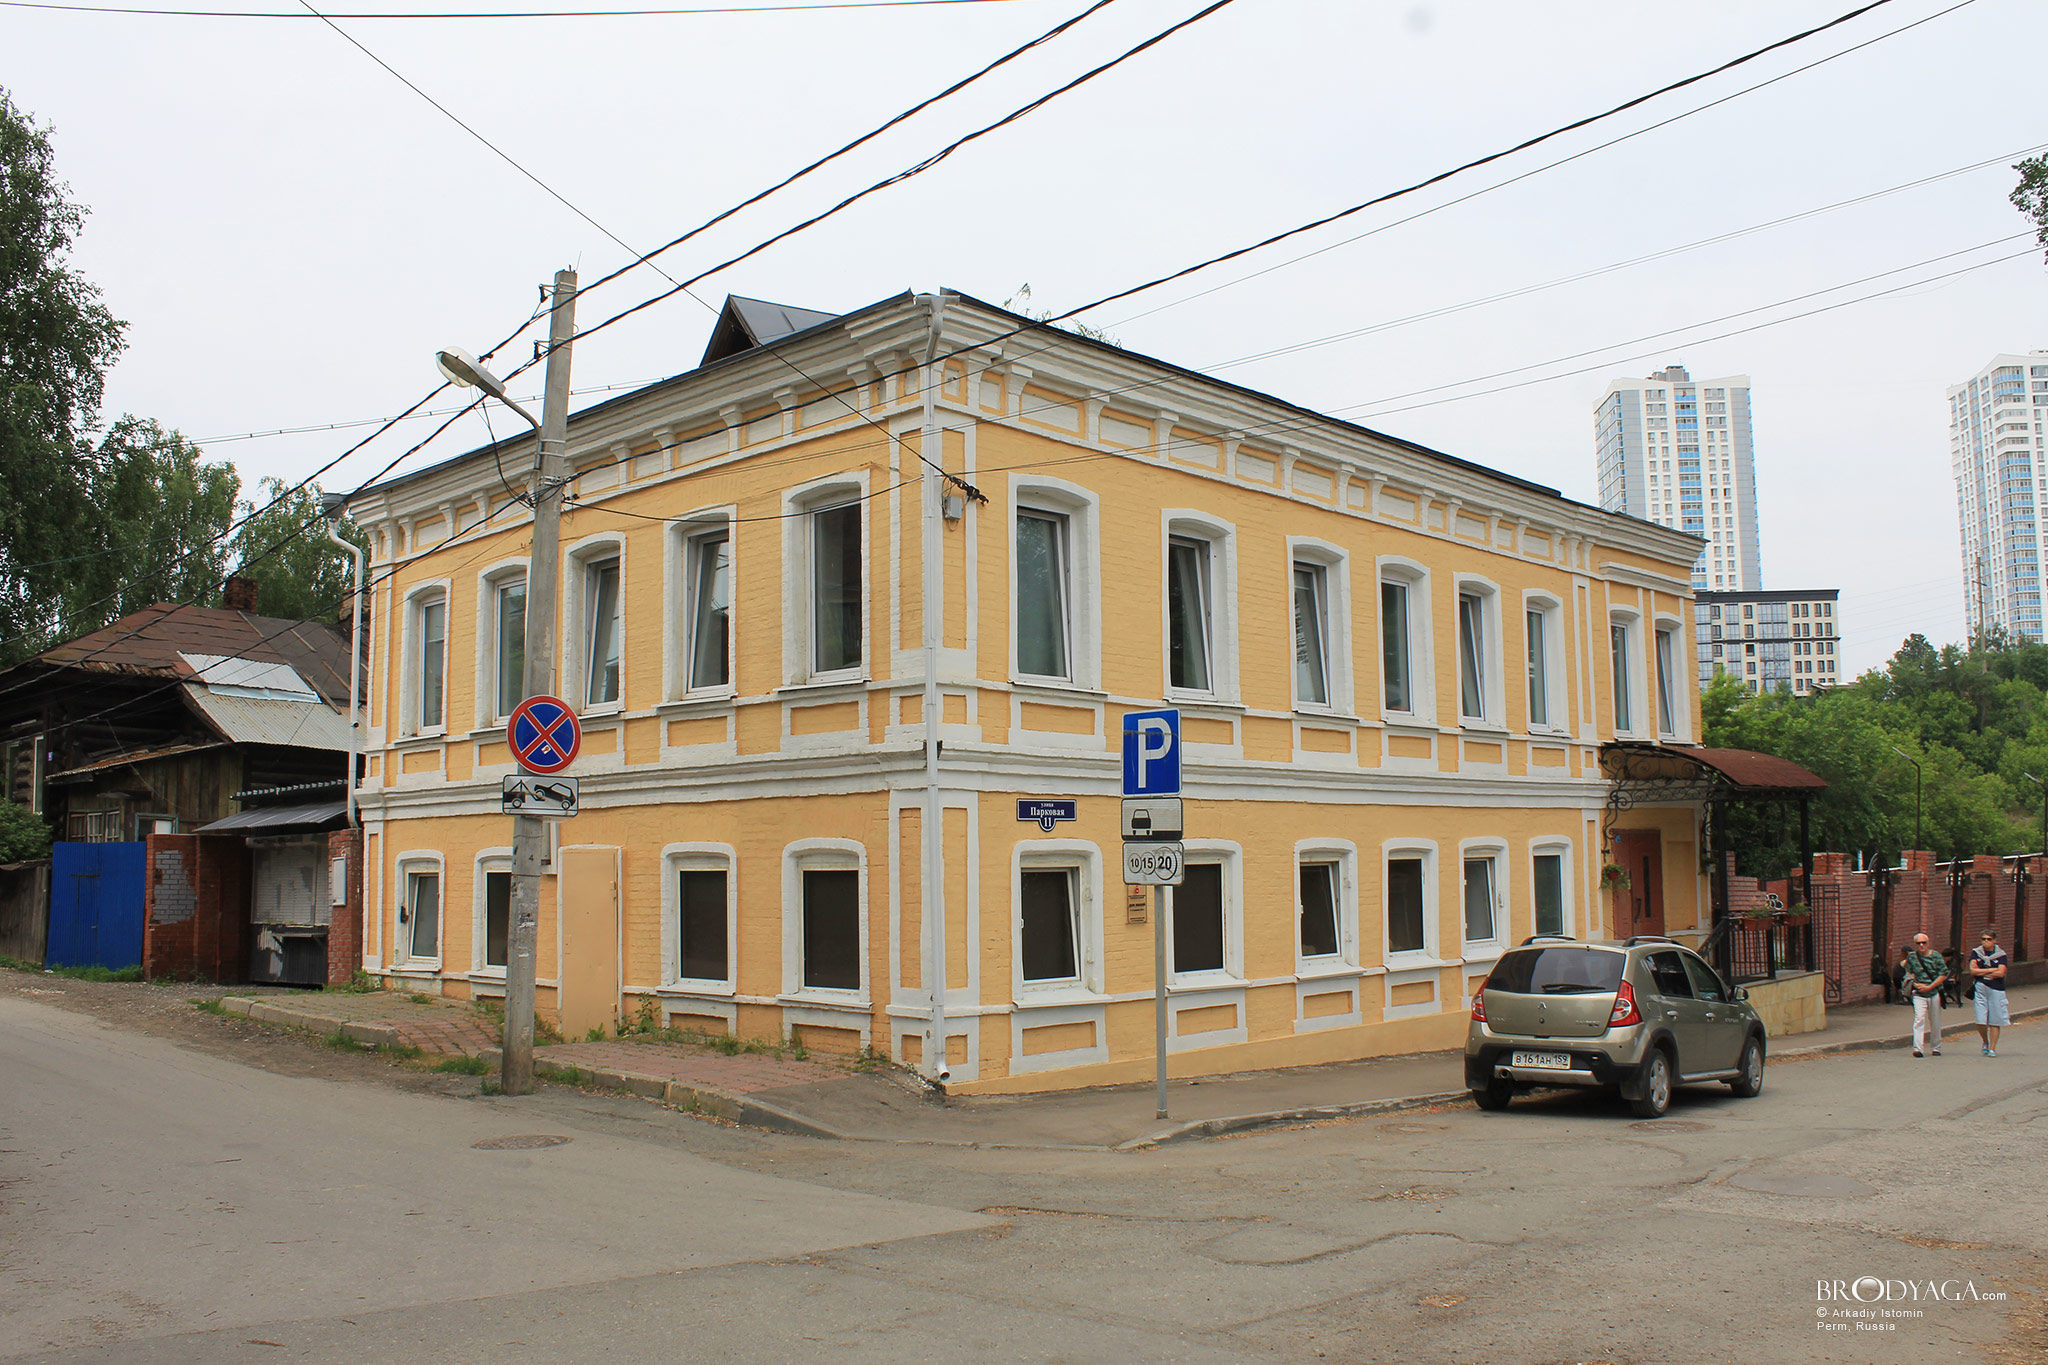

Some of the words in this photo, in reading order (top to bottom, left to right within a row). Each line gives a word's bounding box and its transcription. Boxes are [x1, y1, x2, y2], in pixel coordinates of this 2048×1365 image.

[1137, 717, 1173, 789] P
[1030, 807, 1065, 818] Парковая
[1044, 817, 1052, 827] 11
[1131, 859, 1140, 868] 10
[1142, 857, 1154, 869] 15
[1157, 856, 1172, 870] 20
